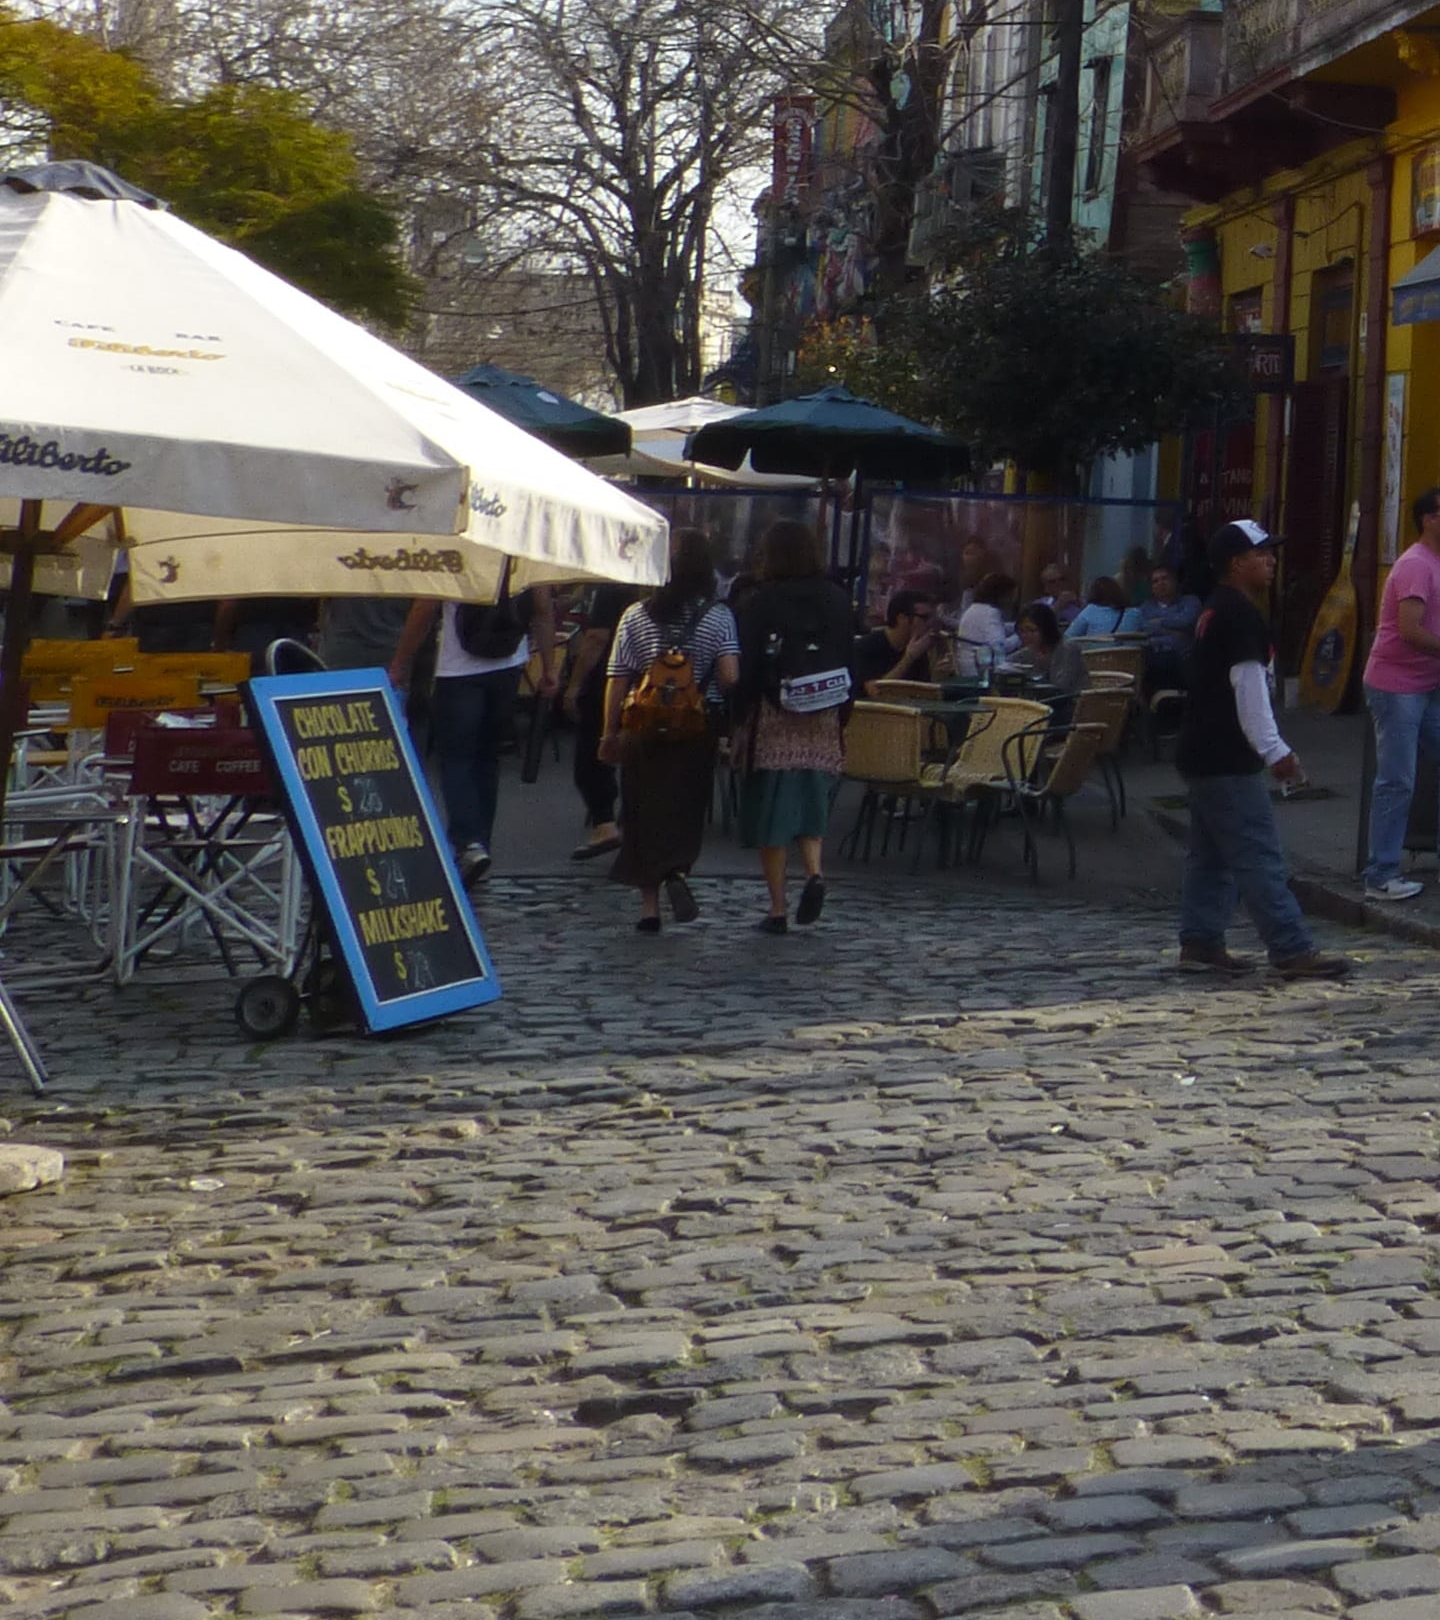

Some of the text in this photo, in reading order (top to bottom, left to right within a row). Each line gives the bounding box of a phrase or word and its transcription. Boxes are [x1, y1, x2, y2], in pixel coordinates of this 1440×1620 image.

[293, 701, 379, 739] CHOCOLATE
[297, 738, 400, 781] CON CHURROS
[337, 784, 352, 814] $
[366, 867, 382, 896] $
[358, 898, 449, 947] MILKSHAKE
[394, 951, 408, 980] $
